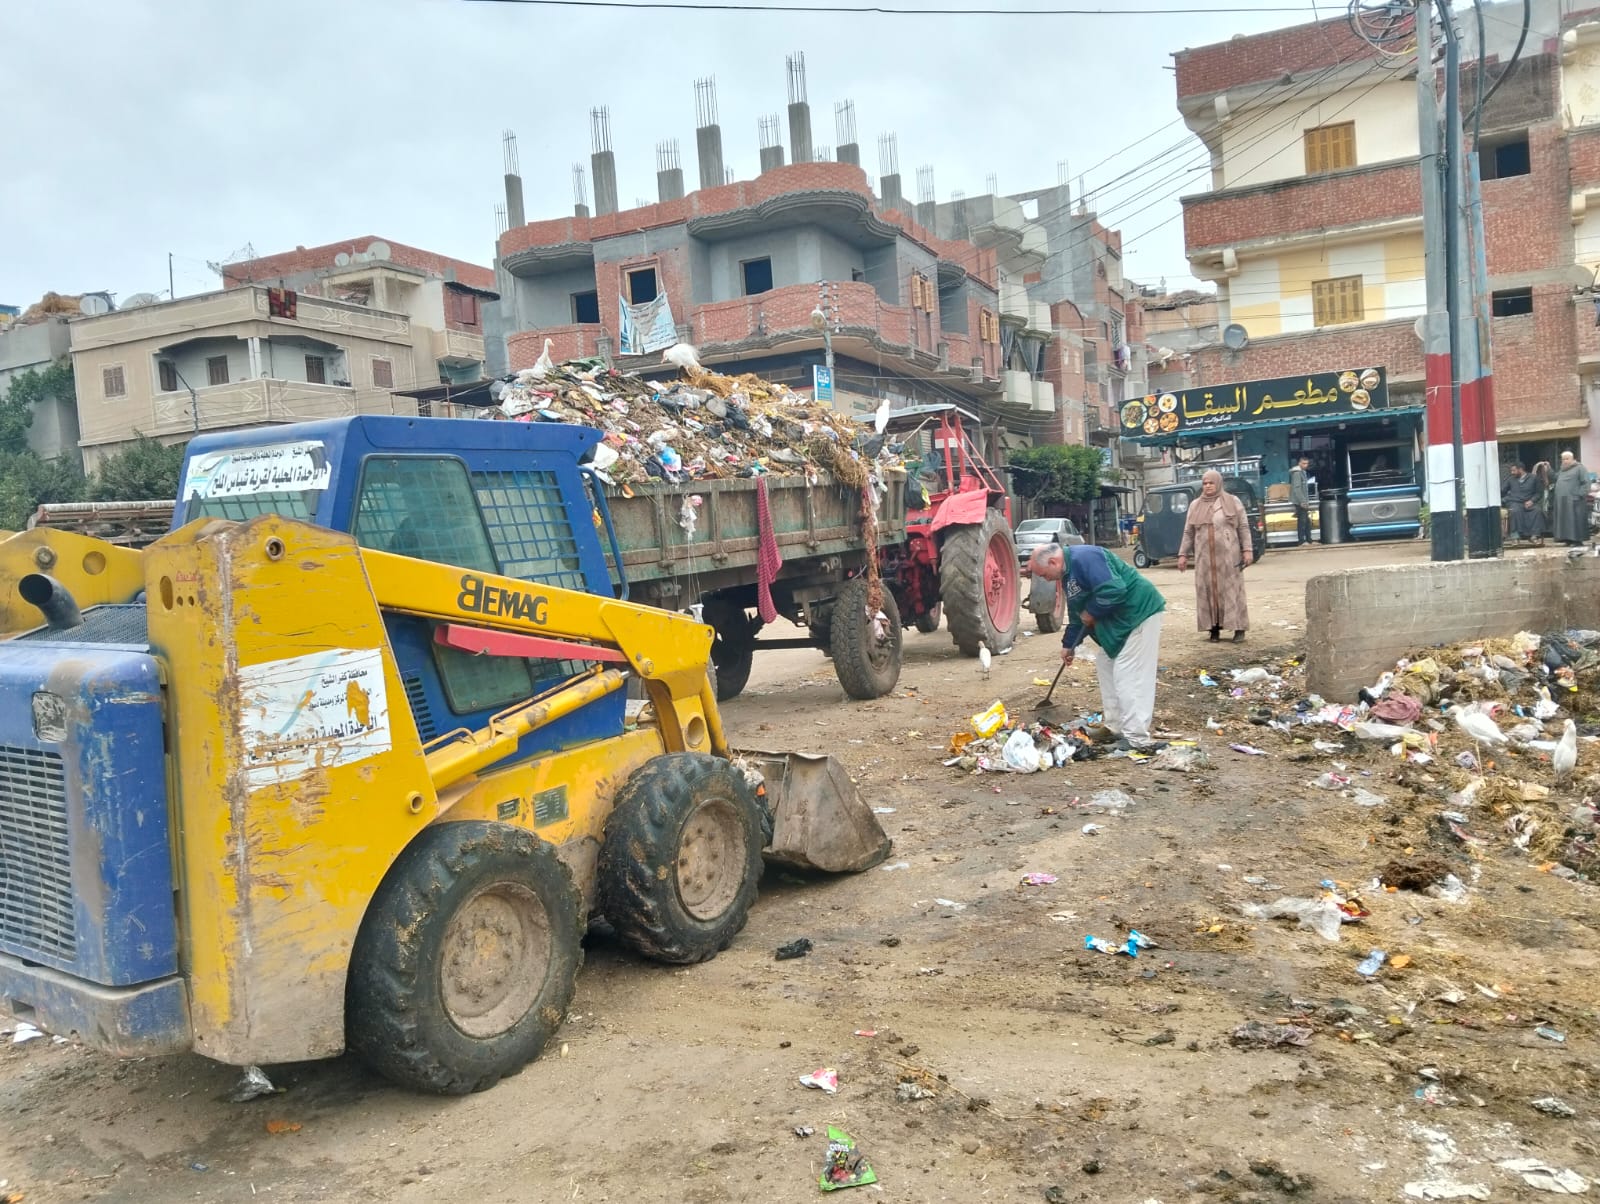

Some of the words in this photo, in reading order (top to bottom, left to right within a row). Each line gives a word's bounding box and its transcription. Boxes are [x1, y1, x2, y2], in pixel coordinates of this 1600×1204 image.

[1181, 385, 1248, 419] السقا
[1252, 378, 1338, 416] مطعم
[249, 468, 271, 491] لقرية
[271, 466, 296, 488] المحلية
[296, 466, 325, 486] الوحدة
[457, 574, 549, 625] BEMAG
[321, 673, 337, 689] الشيخ
[337, 671, 348, 685] كفر
[348, 668, 368, 679] محافظة
[348, 715, 378, 735] الحدة
